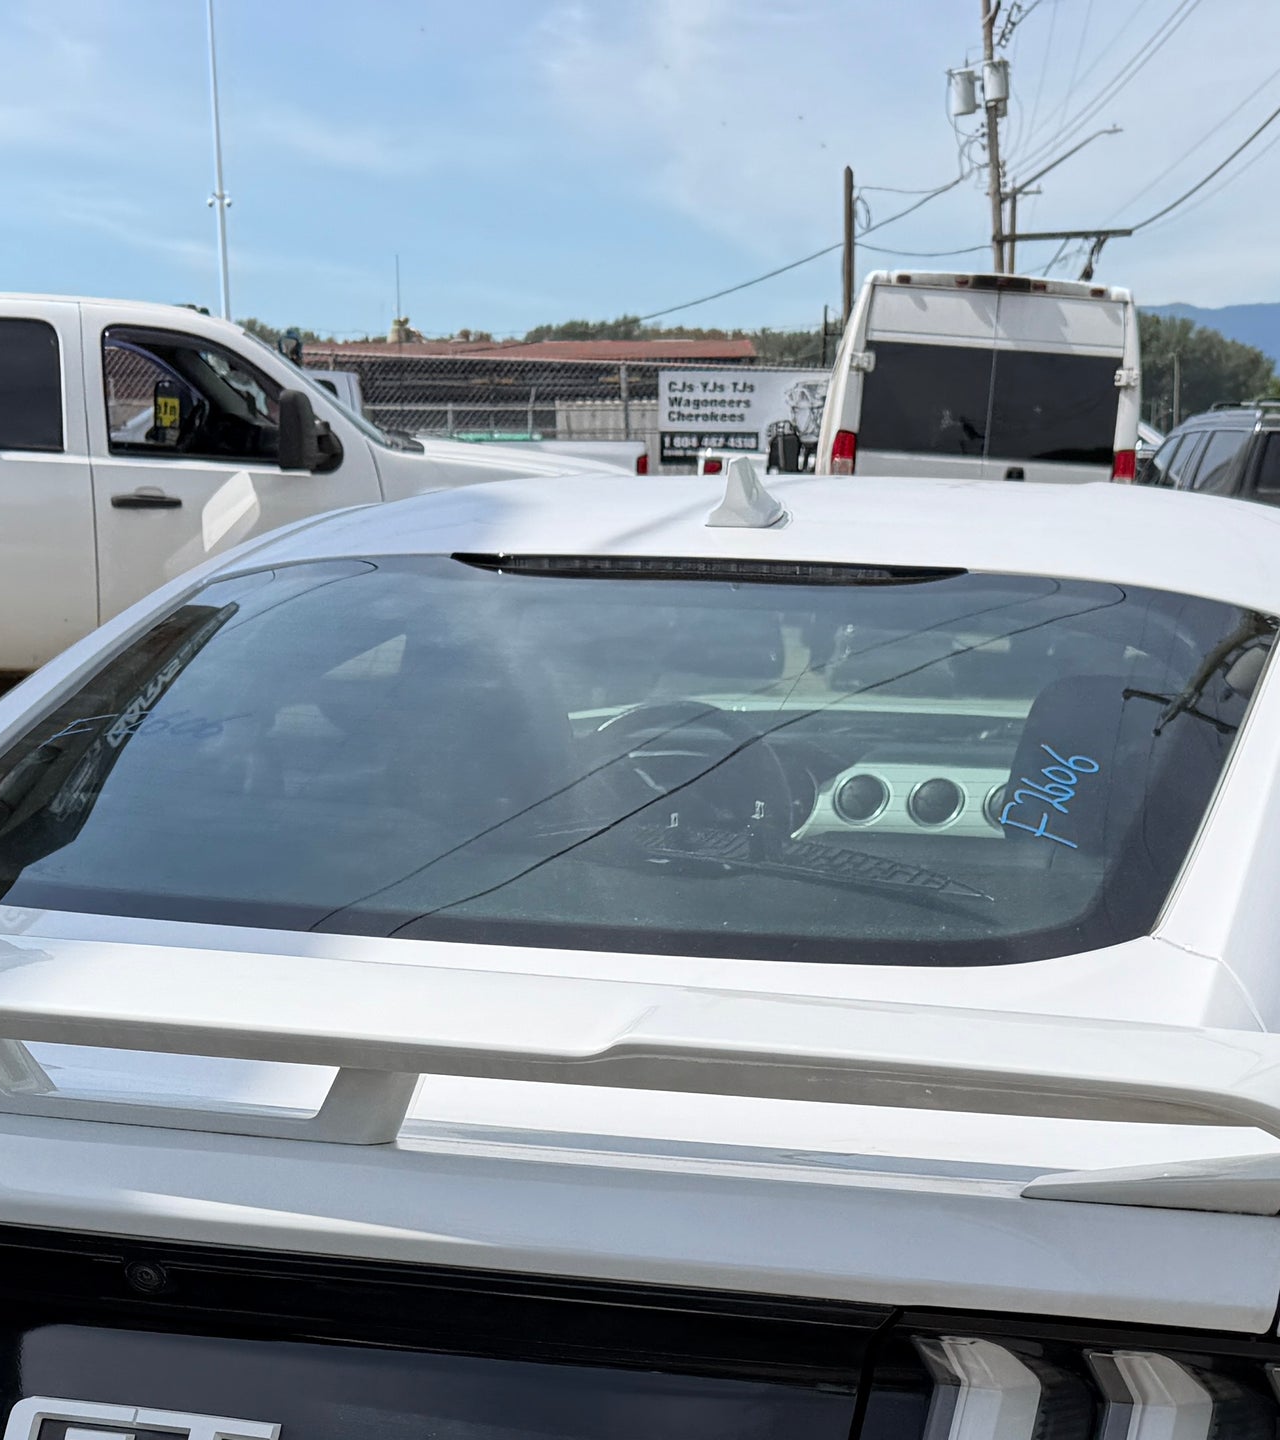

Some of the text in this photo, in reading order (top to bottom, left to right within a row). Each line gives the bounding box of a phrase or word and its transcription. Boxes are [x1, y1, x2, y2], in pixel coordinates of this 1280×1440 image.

[668, 396, 752, 410] Wagoneers
[668, 411, 746, 423] Cherokees
[998, 743, 1100, 849] F2606
